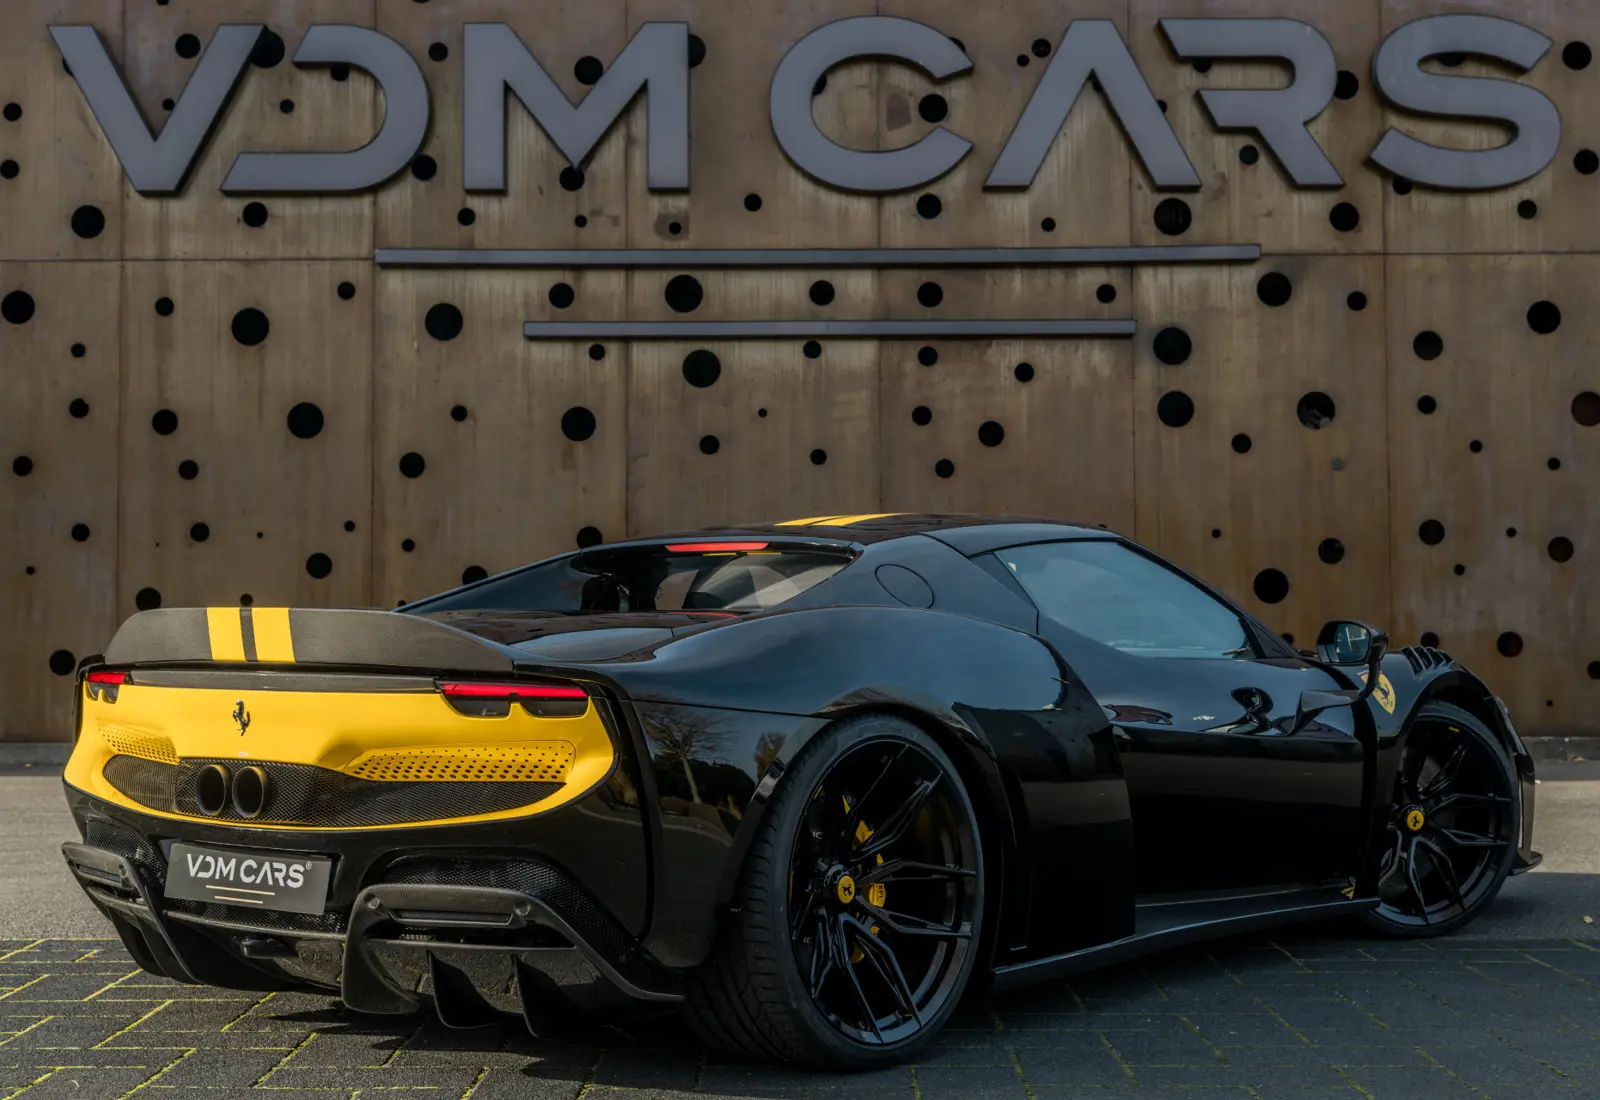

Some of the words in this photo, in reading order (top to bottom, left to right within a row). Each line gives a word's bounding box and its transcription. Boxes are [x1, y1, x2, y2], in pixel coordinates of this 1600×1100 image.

[48, 22, 690, 195] VDM
[769, 14, 1563, 192] CARS
[186, 853, 237, 882] VDM
